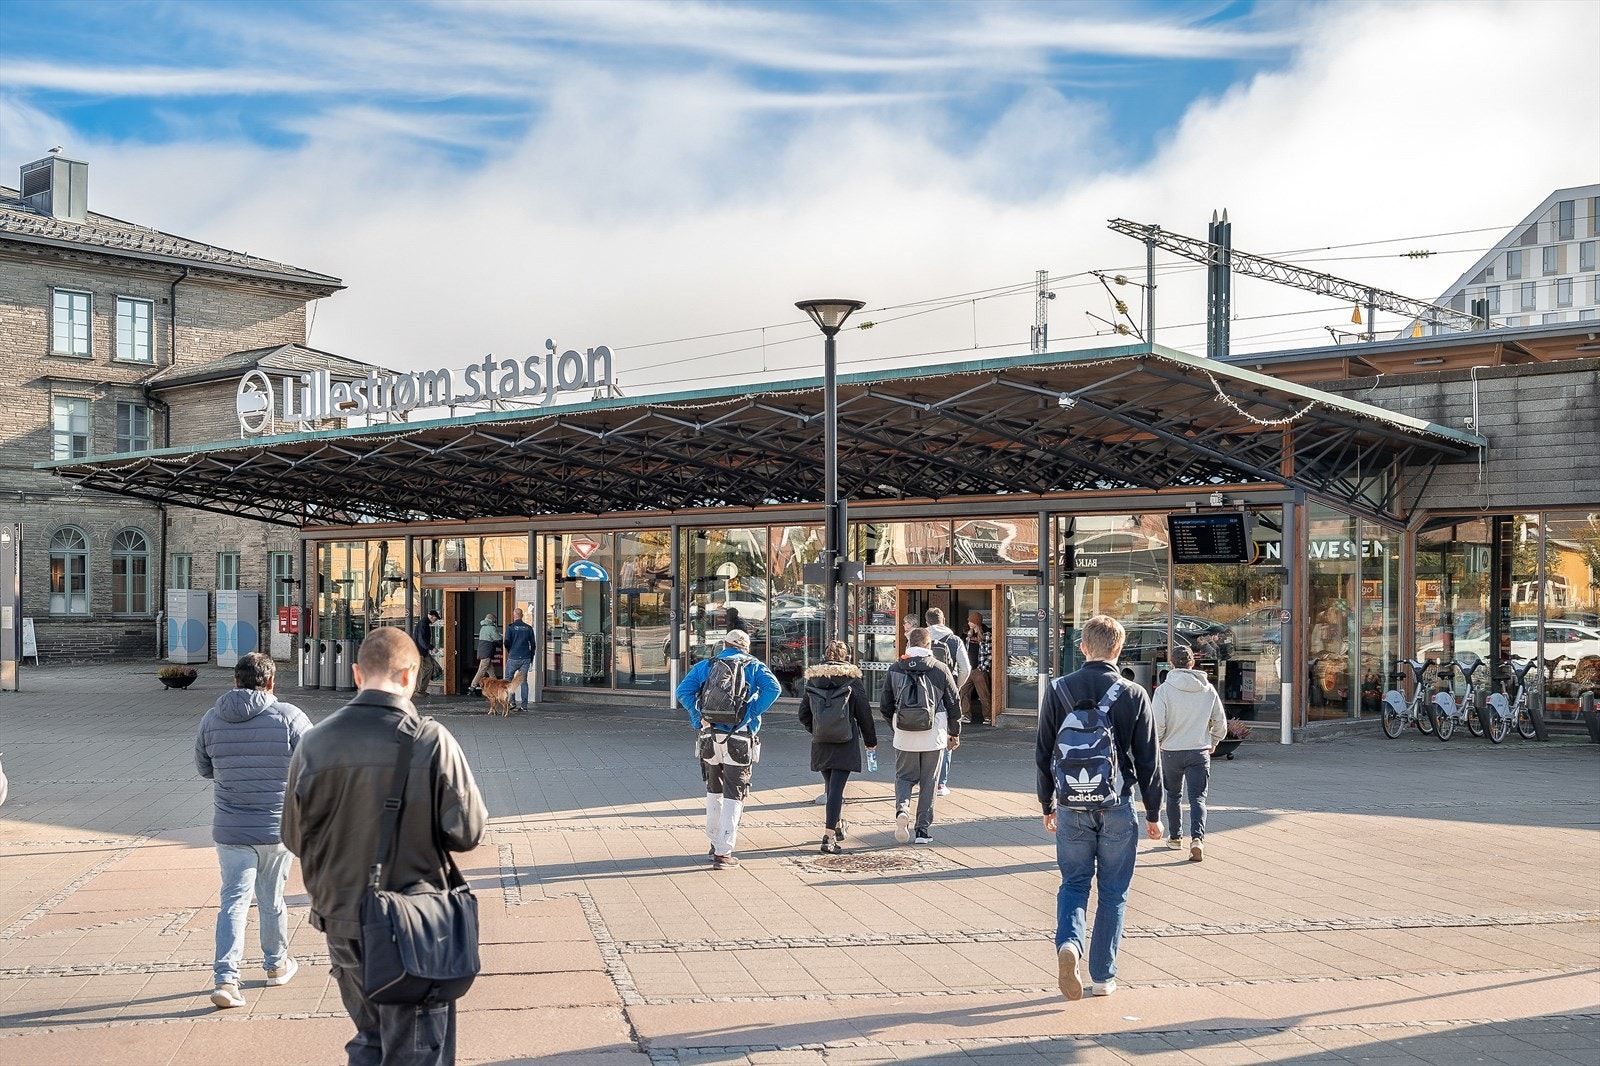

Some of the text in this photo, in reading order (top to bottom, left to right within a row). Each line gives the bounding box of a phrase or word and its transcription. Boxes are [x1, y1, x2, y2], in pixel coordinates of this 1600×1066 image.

[282, 338, 616, 422] Lillestrøm stasjon
[1266, 540, 1384, 559] NVESEN
[1067, 793, 1105, 802] adidas
